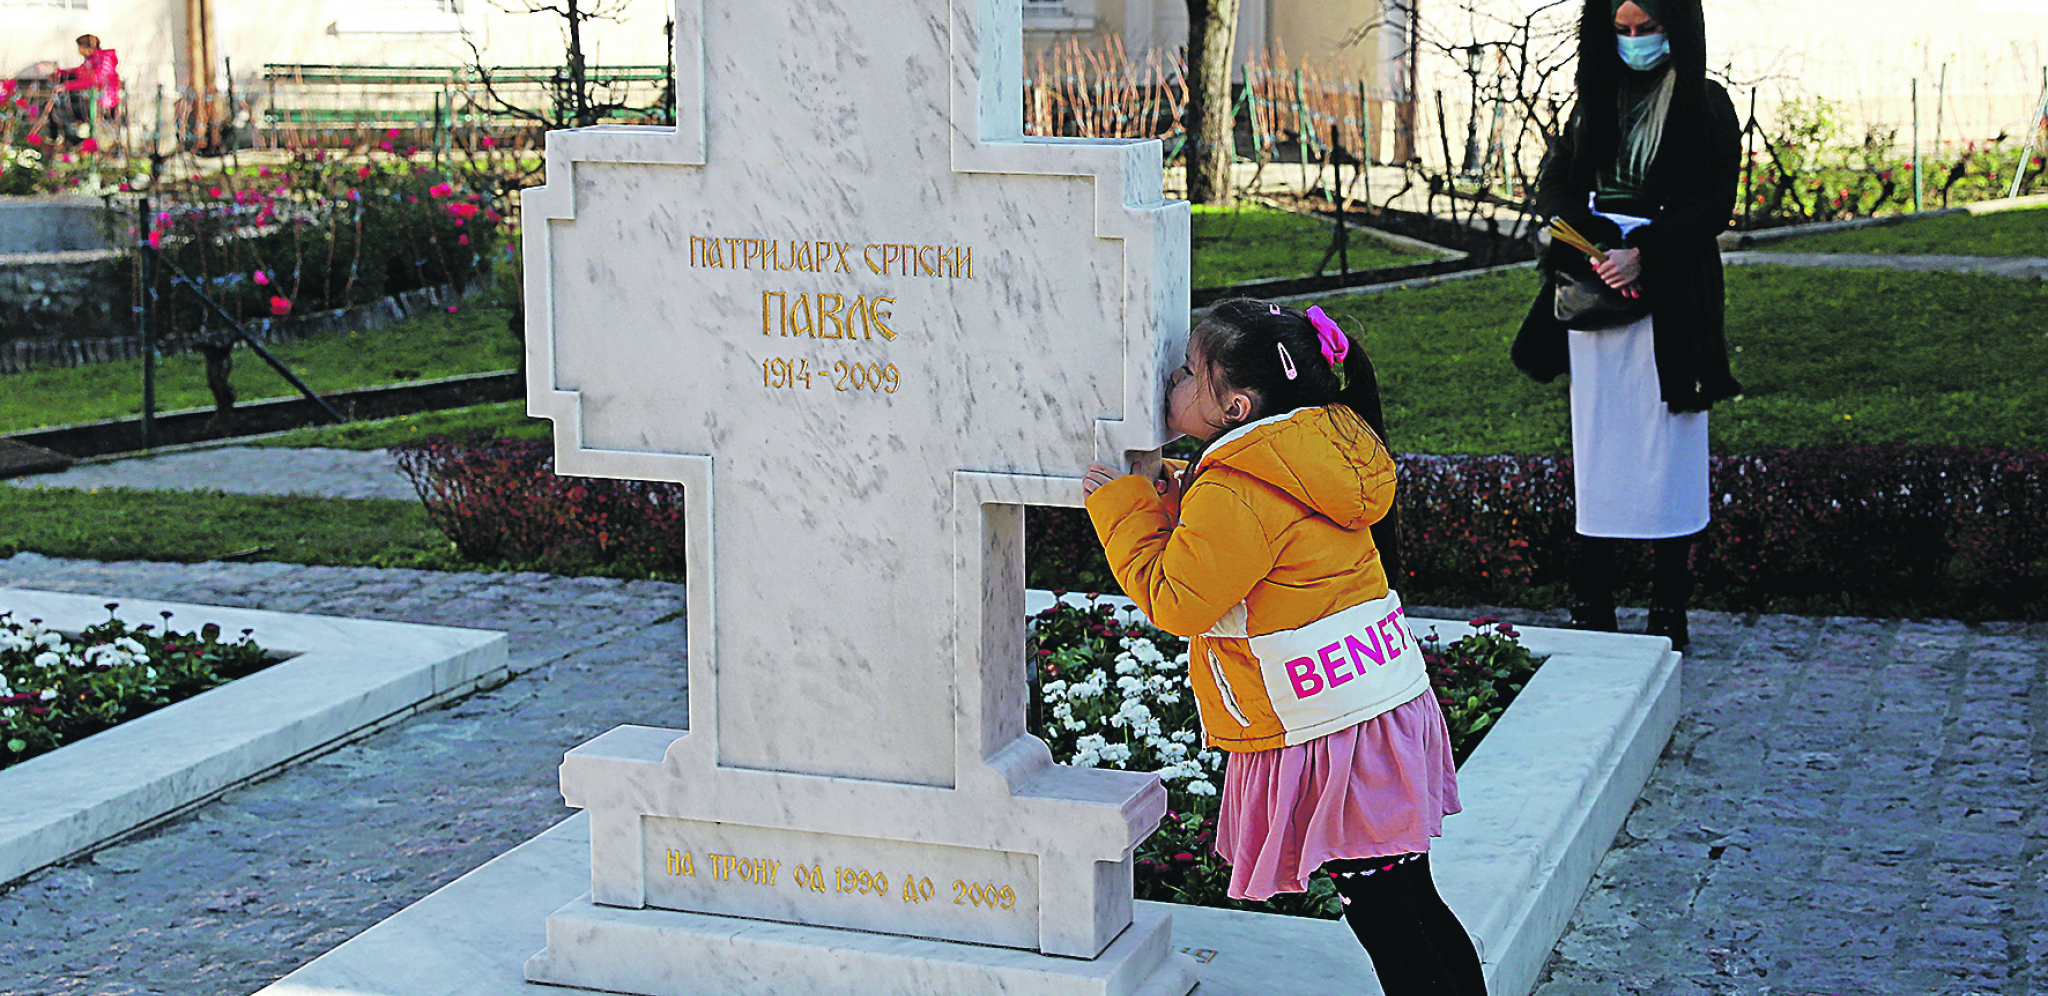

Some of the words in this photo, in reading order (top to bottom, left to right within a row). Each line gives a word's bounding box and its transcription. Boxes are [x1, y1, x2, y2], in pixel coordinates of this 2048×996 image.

[689, 236, 852, 274] ПАТРИЈАРХ
[864, 243, 973, 279] СРПСКИ
[666, 849, 696, 877] НА
[707, 853, 782, 886] ТРОНУ
[793, 863, 827, 893] ОД
[834, 866, 889, 896] 1990
[902, 874, 935, 904] ДО
[952, 879, 1016, 911] 2009
